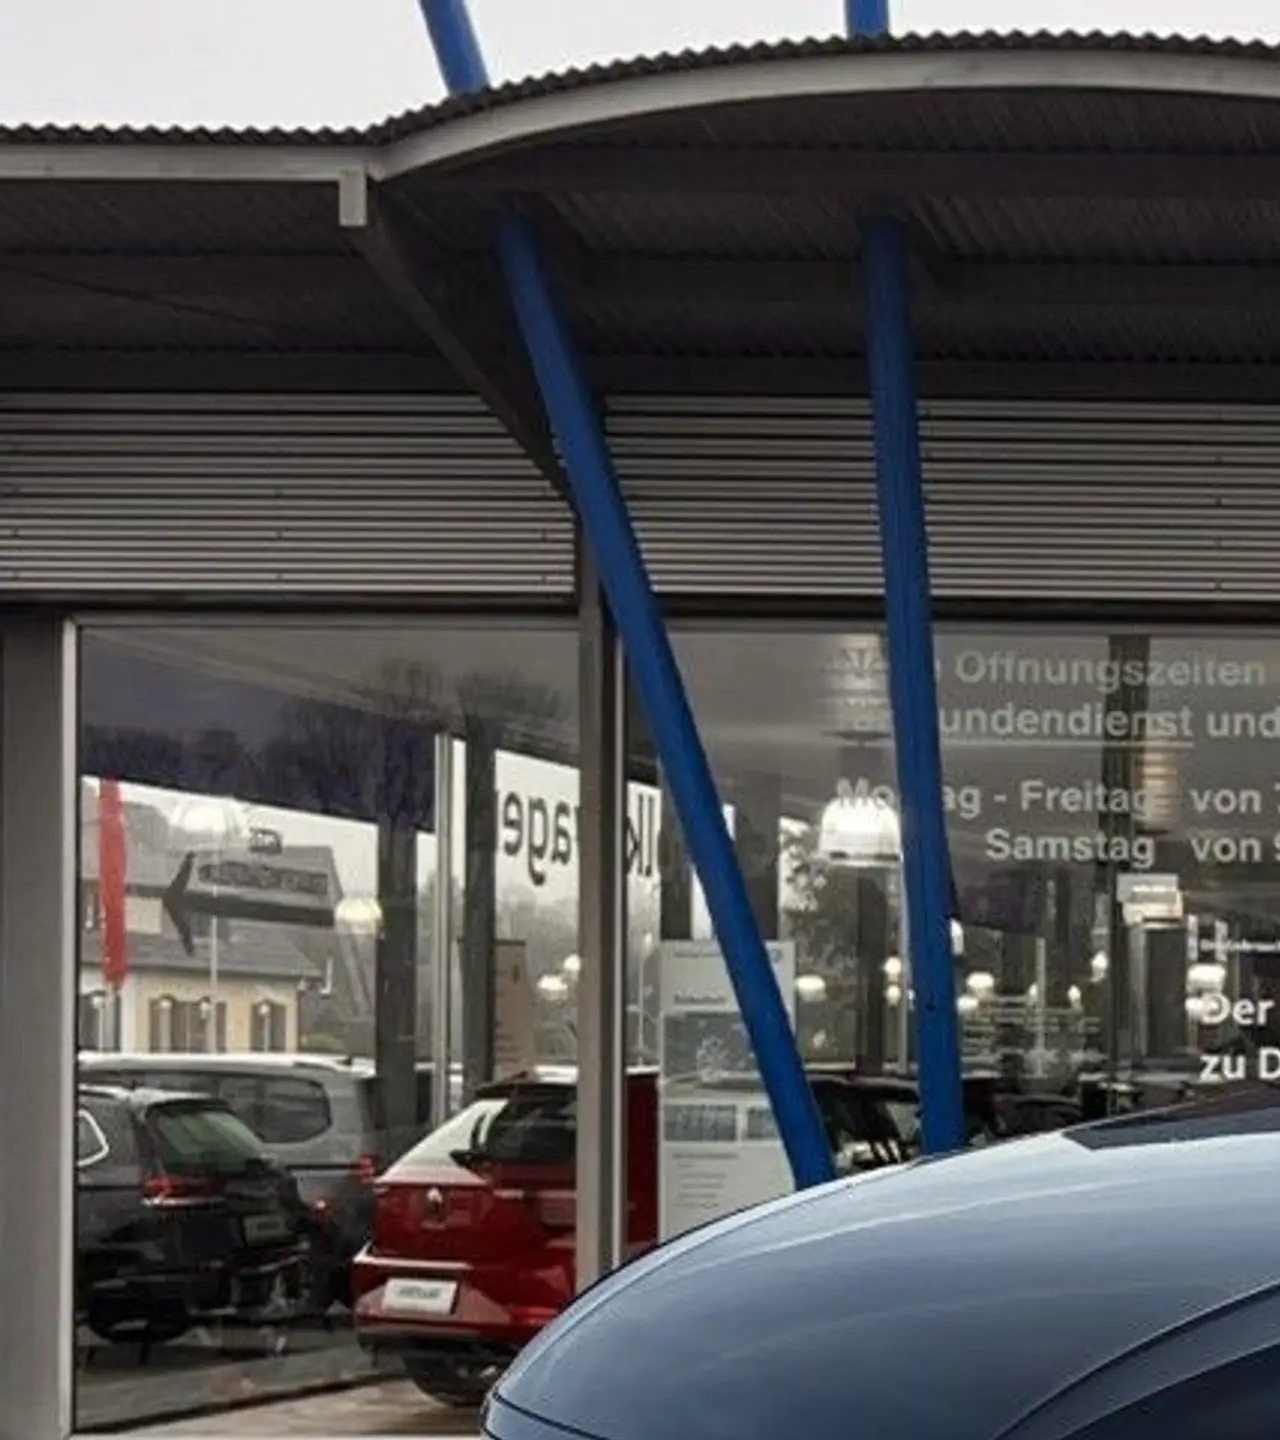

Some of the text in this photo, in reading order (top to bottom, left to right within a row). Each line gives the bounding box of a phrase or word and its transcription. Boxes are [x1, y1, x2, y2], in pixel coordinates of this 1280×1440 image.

[938, 703, 1194, 737] undendienst
[1021, 780, 1155, 819] Freitag
[1190, 788, 1262, 814] von
[986, 827, 1154, 866] Samstag
[1190, 837, 1262, 863] von
[1200, 993, 1275, 1025] Der
[1200, 1055, 1246, 1081] zu
